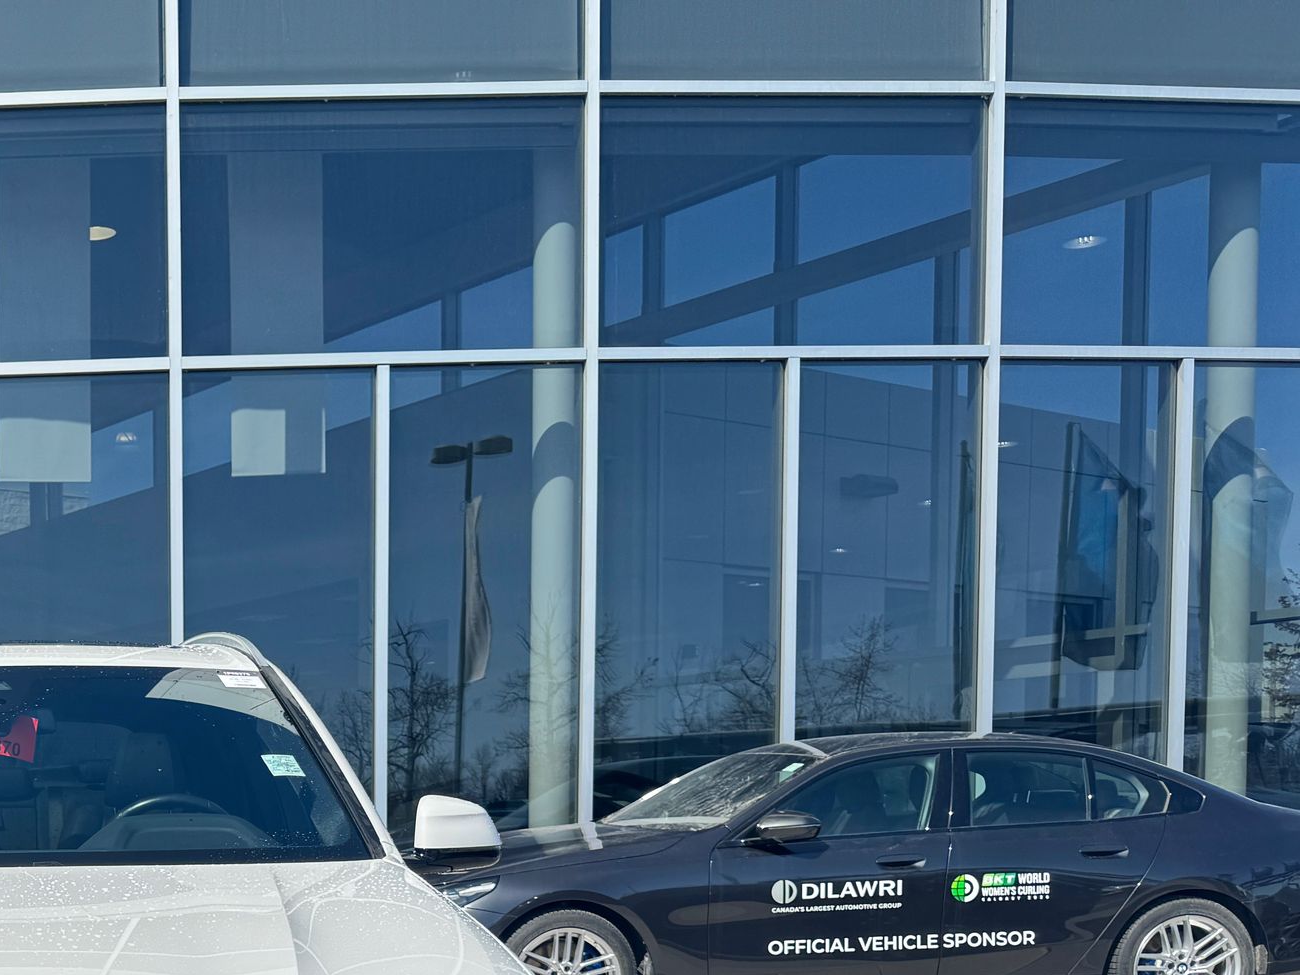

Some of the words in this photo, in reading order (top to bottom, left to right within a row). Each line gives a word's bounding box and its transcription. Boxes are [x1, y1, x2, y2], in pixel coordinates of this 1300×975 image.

[981, 873, 1017, 887] BKT
[1017, 872, 1051, 884] WORLD
[801, 880, 903, 900] DILAWRI
[981, 886, 1017, 897] WOMEN'S
[1017, 885, 1051, 895] CURLING
[771, 906, 805, 914] CANADA'S
[835, 902, 878, 911] AUTOMOTIVE
[767, 938, 856, 955] OFFICIAL
[858, 933, 940, 952] VEHICLE
[942, 930, 1036, 948] SPONSOR
